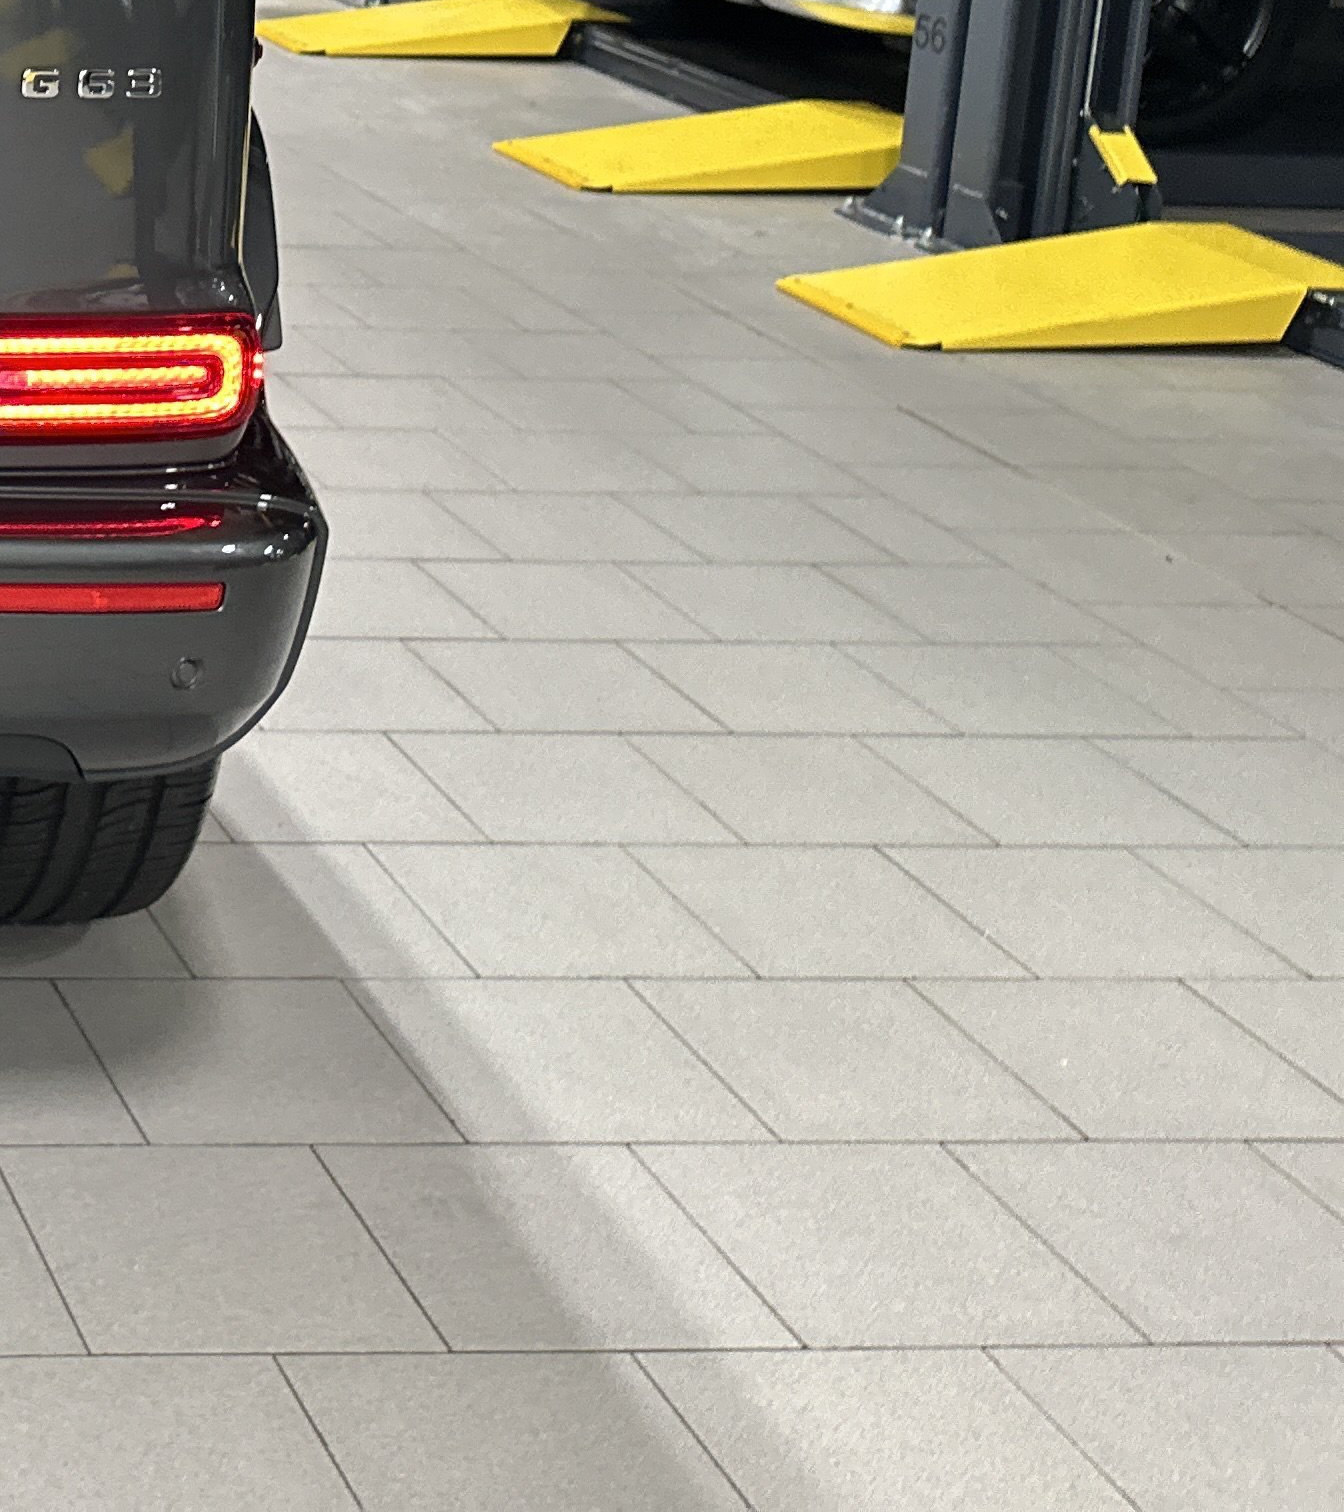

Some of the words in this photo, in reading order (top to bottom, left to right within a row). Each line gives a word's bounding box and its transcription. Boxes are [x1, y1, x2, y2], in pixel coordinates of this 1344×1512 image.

[915, 13, 947, 55] 56
[21, 68, 60, 99] G
[77, 68, 162, 99] 63
